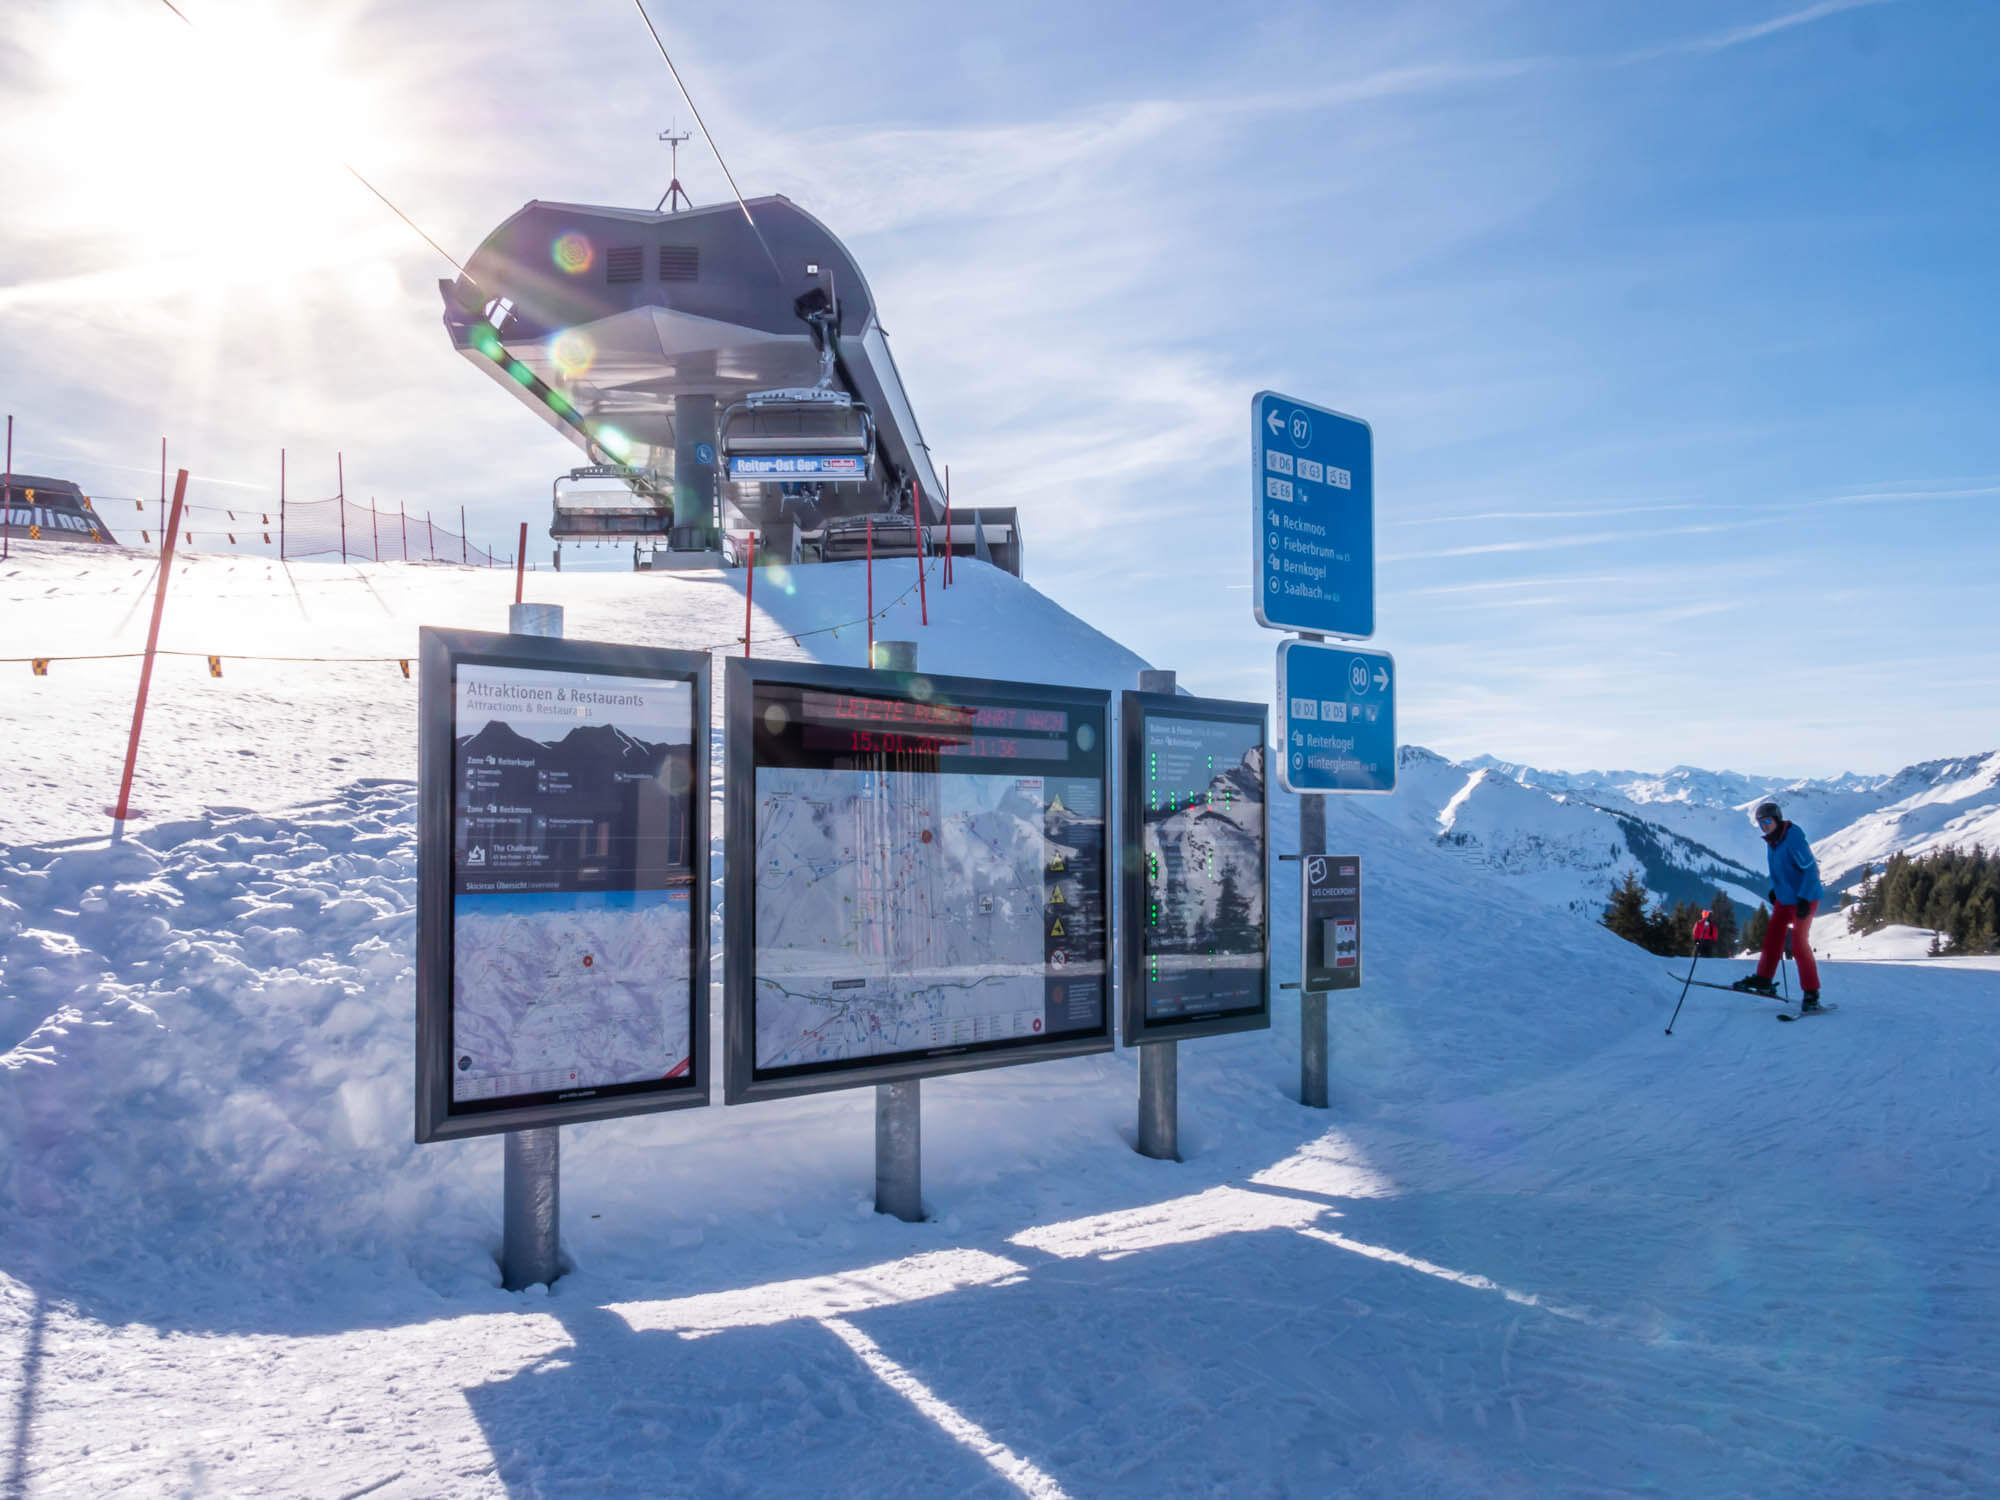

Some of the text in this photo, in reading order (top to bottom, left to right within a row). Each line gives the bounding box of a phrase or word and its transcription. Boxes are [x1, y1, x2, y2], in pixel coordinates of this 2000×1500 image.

[1293, 418, 1308, 440] 87
[1279, 455, 1292, 472] D6
[1283, 514, 1326, 537] Reckmoos
[1284, 536, 1335, 559] Fieberbrunn
[1283, 558, 1327, 580] Bernkogel
[1284, 580, 1323, 600] Saalbach
[1352, 666, 1367, 687] 80
[466, 681, 645, 707] Attraktionen & Restaurants
[466, 699, 523, 713] Attractions
[1306, 733, 1354, 752] Reiterkogel
